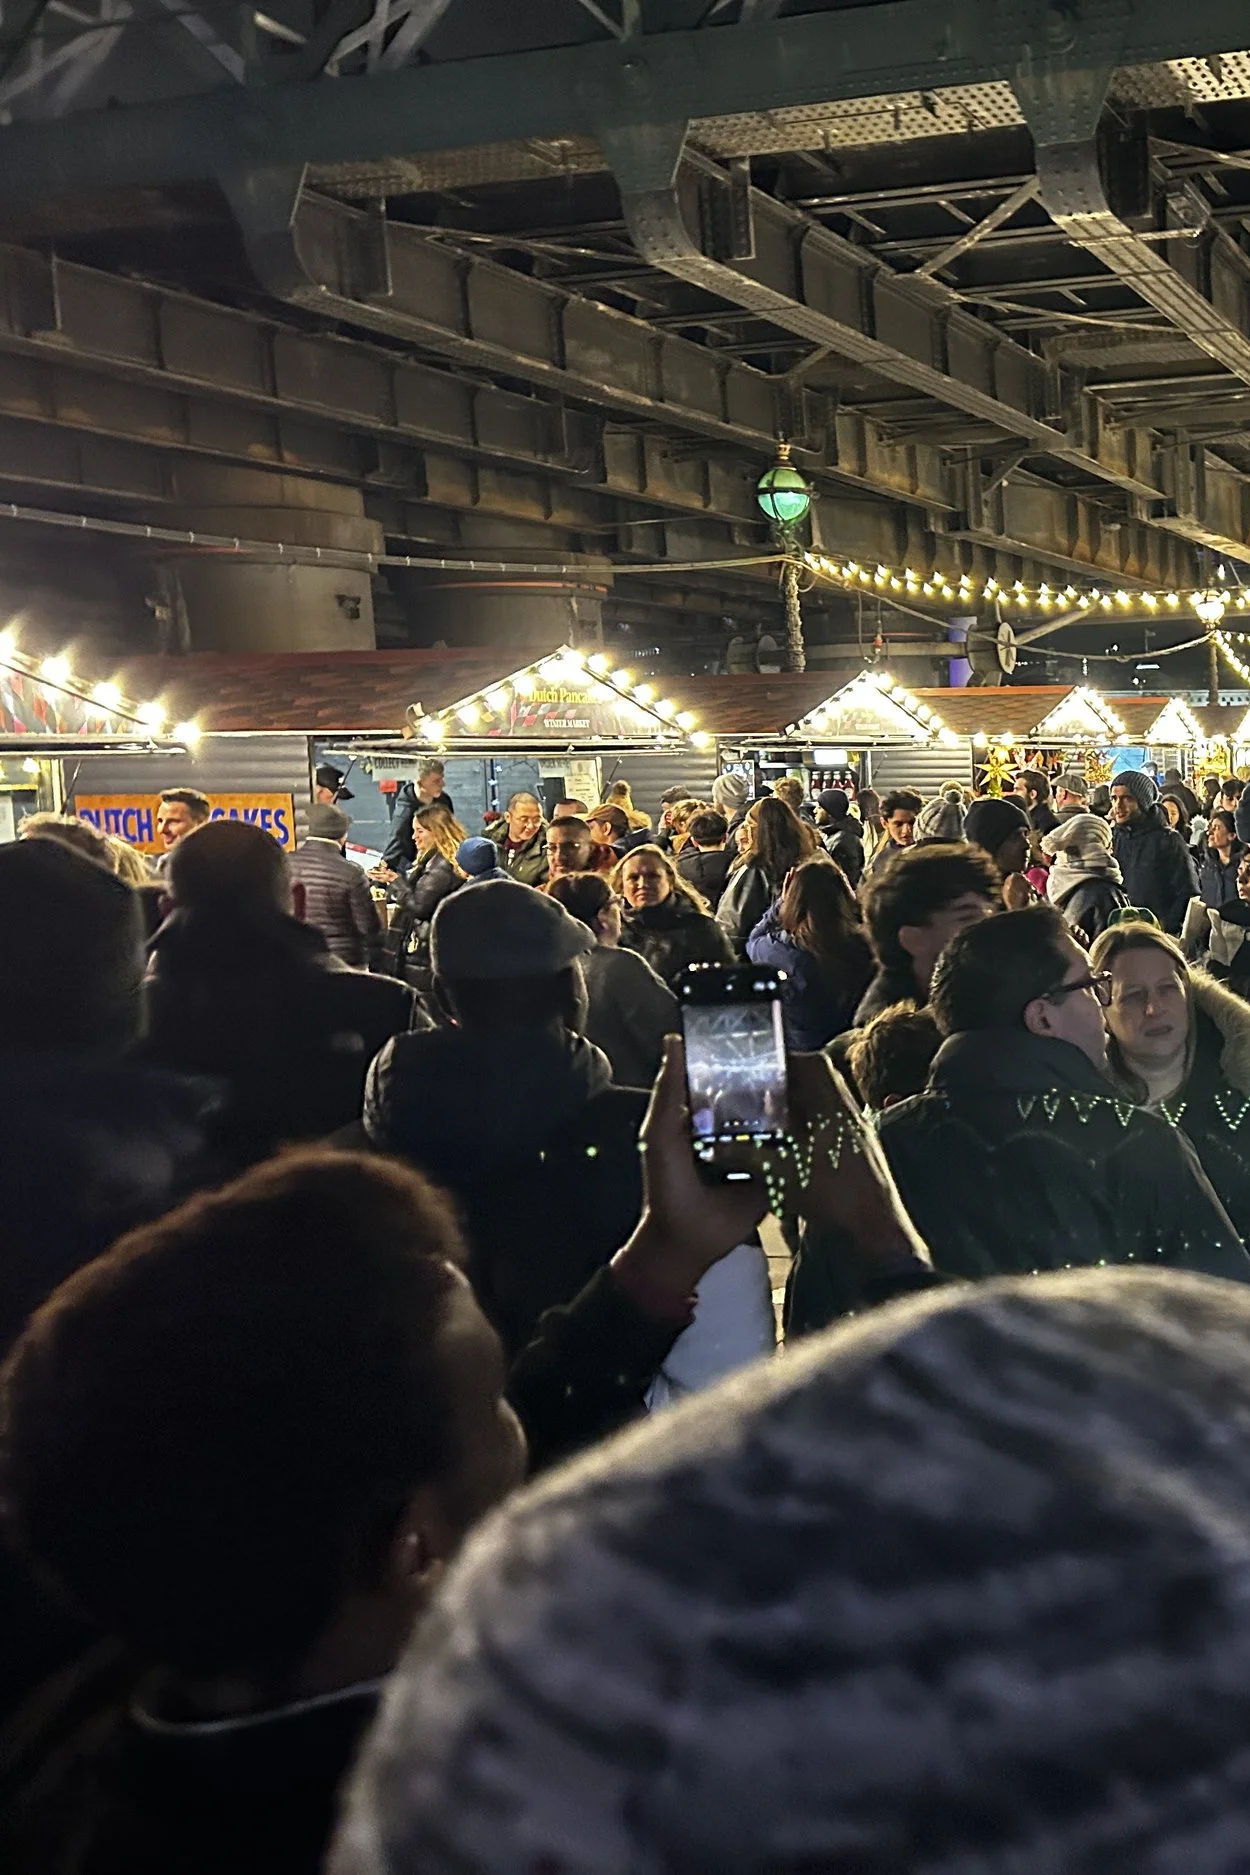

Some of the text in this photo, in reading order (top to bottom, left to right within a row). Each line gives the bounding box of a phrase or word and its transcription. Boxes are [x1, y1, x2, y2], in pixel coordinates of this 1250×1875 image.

[530, 687, 600, 704] Dutch Panca
[544, 719, 590, 728] WINTER MARKET
